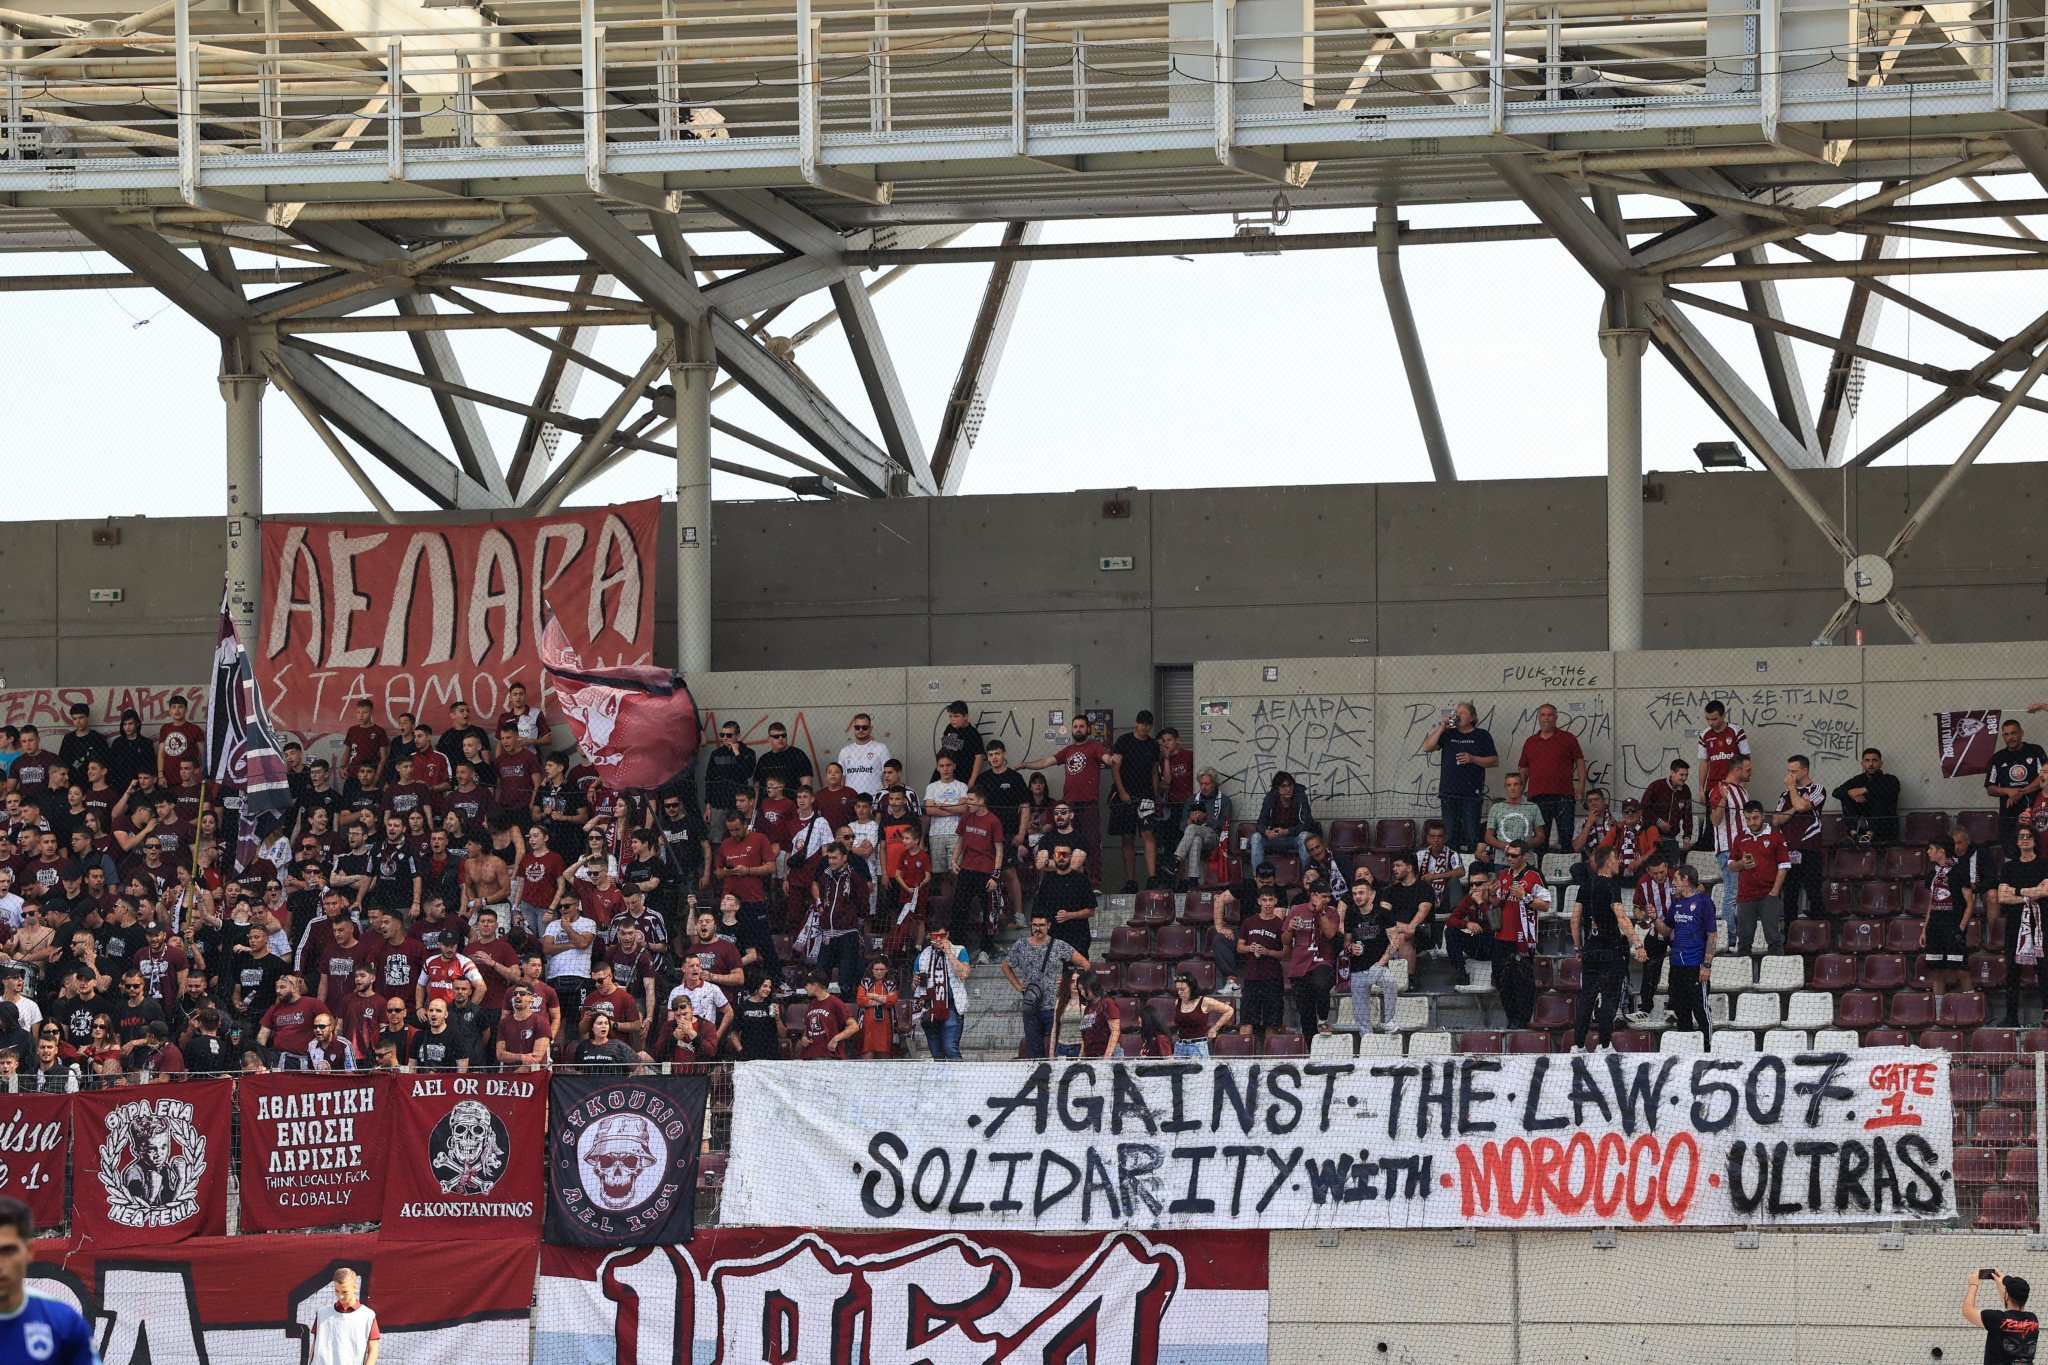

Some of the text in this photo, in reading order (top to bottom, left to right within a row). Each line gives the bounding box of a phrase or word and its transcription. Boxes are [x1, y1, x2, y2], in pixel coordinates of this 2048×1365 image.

[266, 513, 643, 667] ΑΕΛΑΡΑ
[1541, 675, 1599, 688] POLICE
[1560, 665, 1586, 676] THE
[1252, 696, 1371, 723] ΑΕΛΑΡΑ
[1246, 719, 1366, 755] ΘΥΡΑ
[1803, 729, 1863, 759] STREET
[412, 1078, 534, 1098] AEL OR DEAD
[1868, 1063, 1938, 1096] GATE
[257, 1087, 375, 1121] ΑΘΛΗΤΙΚΗ
[985, 1062, 1355, 1137] AGAINST
[1370, 1059, 1500, 1138] THE
[1523, 1055, 1677, 1134] LAW
[106, 1100, 192, 1129] ΘΥΡΑ ΕΝΑ
[562, 1090, 684, 1146] SYKOURIO
[276, 1118, 354, 1147] ΕΝΩΣΗ
[268, 1145, 363, 1173] ΛΑΡΙΣΑΣ
[346, 1169, 371, 1184] FUCK
[860, 1131, 1303, 1222] SOLIDARITY
[1455, 1131, 1700, 1222] MOROCCO
[1726, 1134, 1943, 1214] ULTRAS
[279, 1189, 352, 1207] GLOBALLY
[110, 1204, 144, 1227] ΝΕΑ
